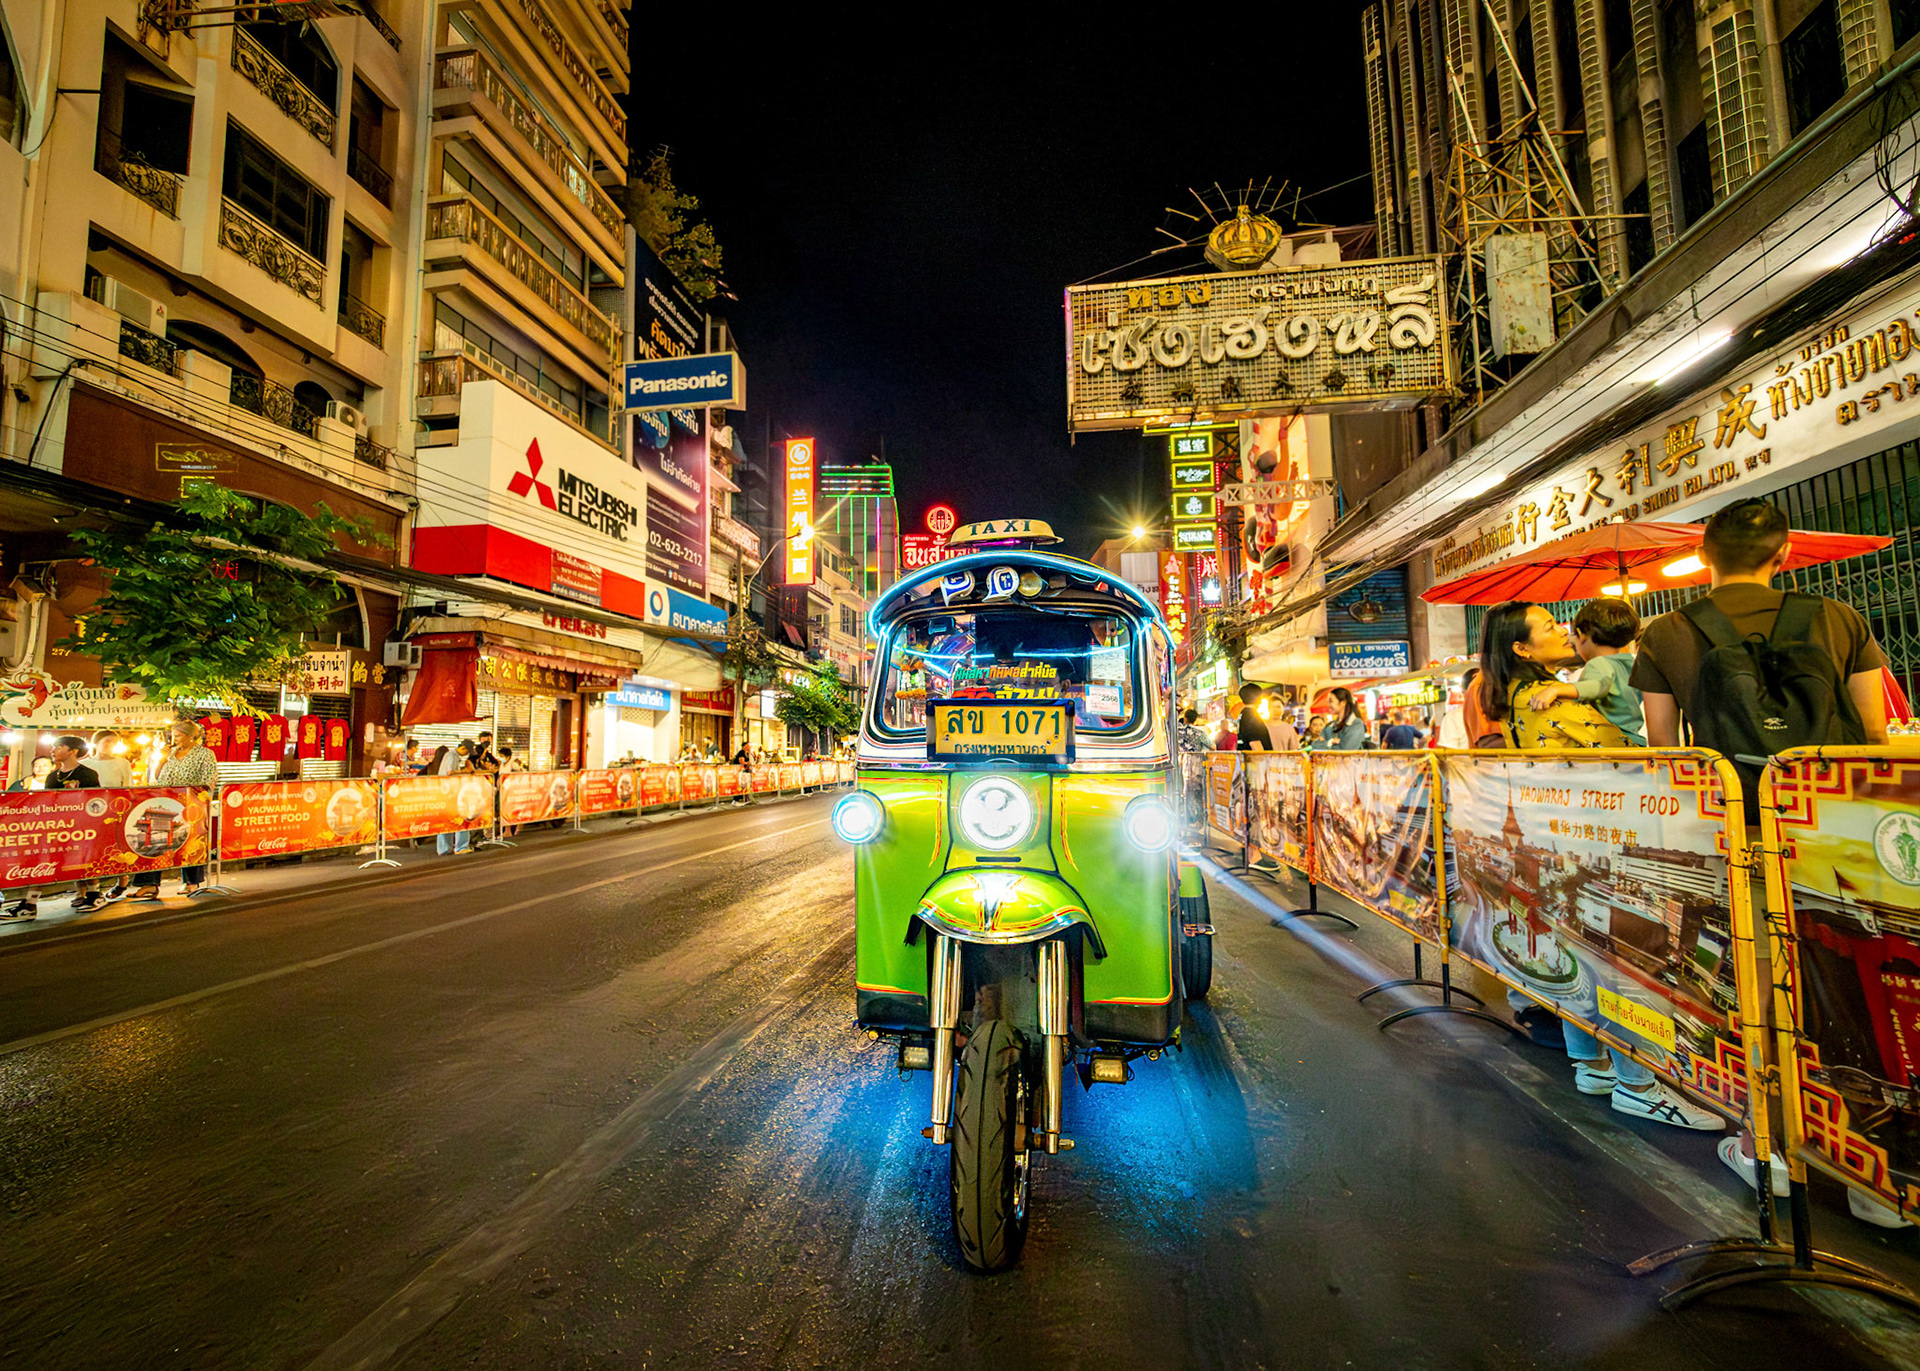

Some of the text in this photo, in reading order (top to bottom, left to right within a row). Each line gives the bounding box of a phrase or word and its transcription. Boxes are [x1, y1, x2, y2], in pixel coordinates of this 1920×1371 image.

[1127, 281, 1212, 309] ทอง
[1083, 273, 1437, 374] เซ่งเฮงหลี
[630, 370, 728, 395] Panasonic
[558, 467, 638, 528] MITSUBISHI
[1642, 484, 1679, 514] SMITH
[558, 491, 628, 543] ELECTRIC
[968, 519, 1031, 536] TAXI
[649, 530, 703, 567] 02-623-2212
[1336, 644, 1362, 655] ทอง
[64, 682, 117, 706] ตุ้งแช่
[947, 708, 1060, 736] สข 1071
[954, 741, 1047, 755] กรงเทพมหานคร
[247, 803, 298, 815] YAOWARAJ
[1519, 785, 1680, 816] YAOWARAJ STREET FOOD
[0, 818, 75, 834] AOWARAJ
[234, 812, 310, 828] STREET FOOD
[0, 828, 97, 848] REET FOOD
[257, 836, 289, 851] Coca-Cola
[6, 861, 60, 881] Coca-Cola
